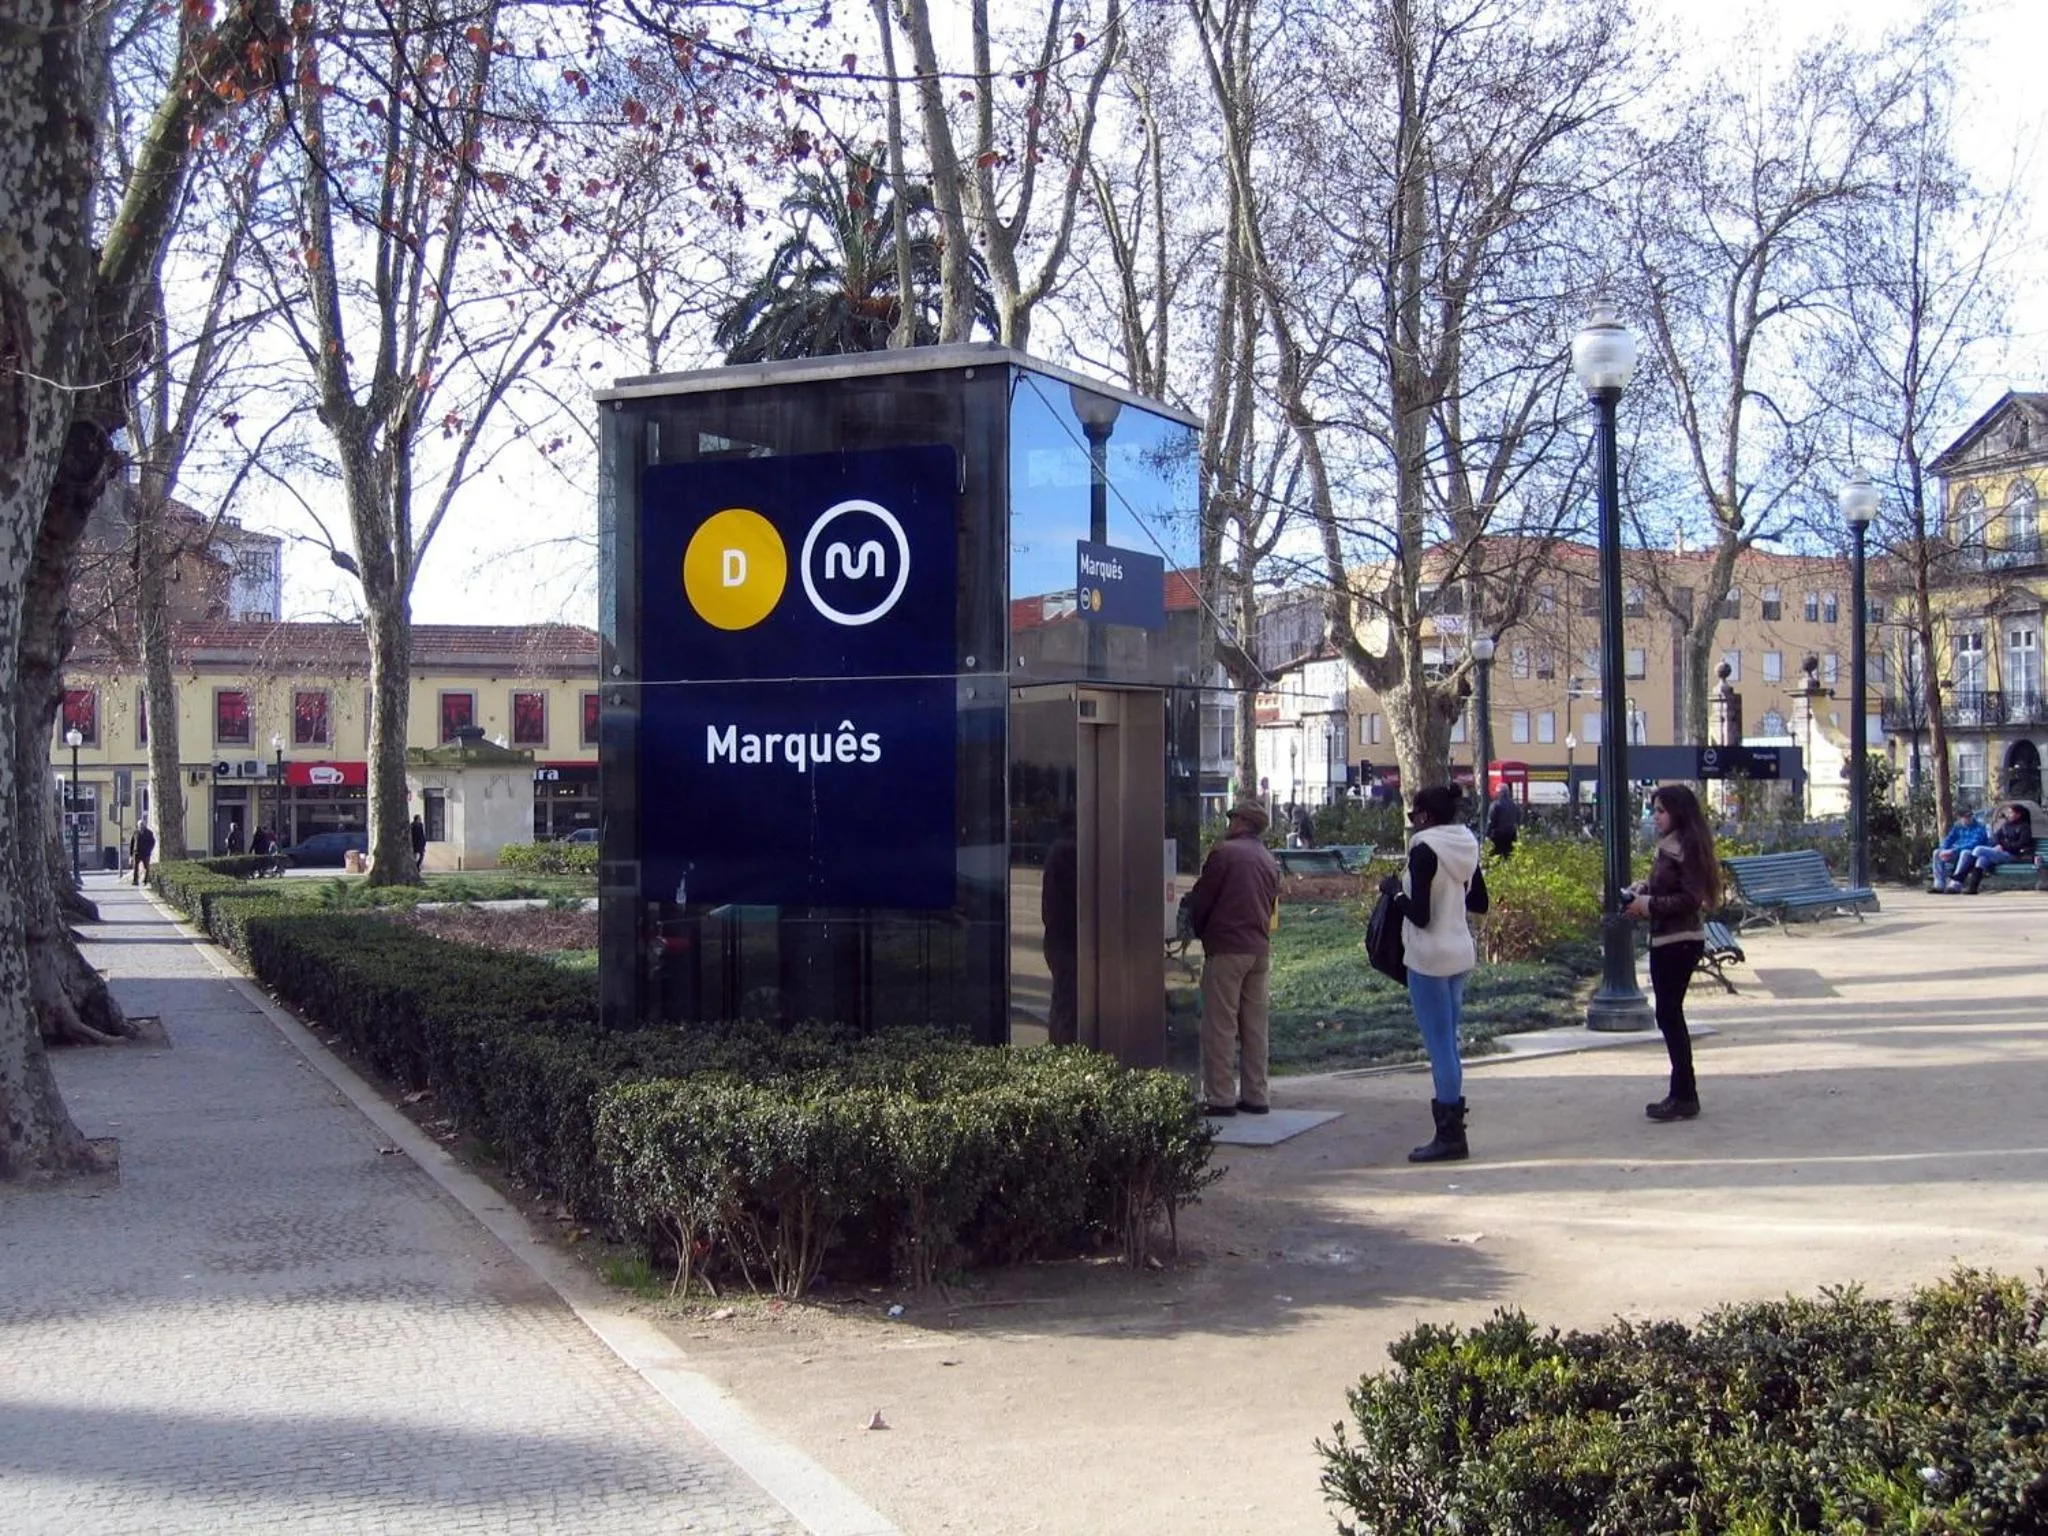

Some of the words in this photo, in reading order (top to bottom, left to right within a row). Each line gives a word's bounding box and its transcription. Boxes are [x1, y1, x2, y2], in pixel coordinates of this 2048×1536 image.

[722, 549, 747, 587] D
[1081, 552, 1123, 582] Marquês
[707, 720, 881, 772] Marquês
[533, 769, 559, 780] ra
